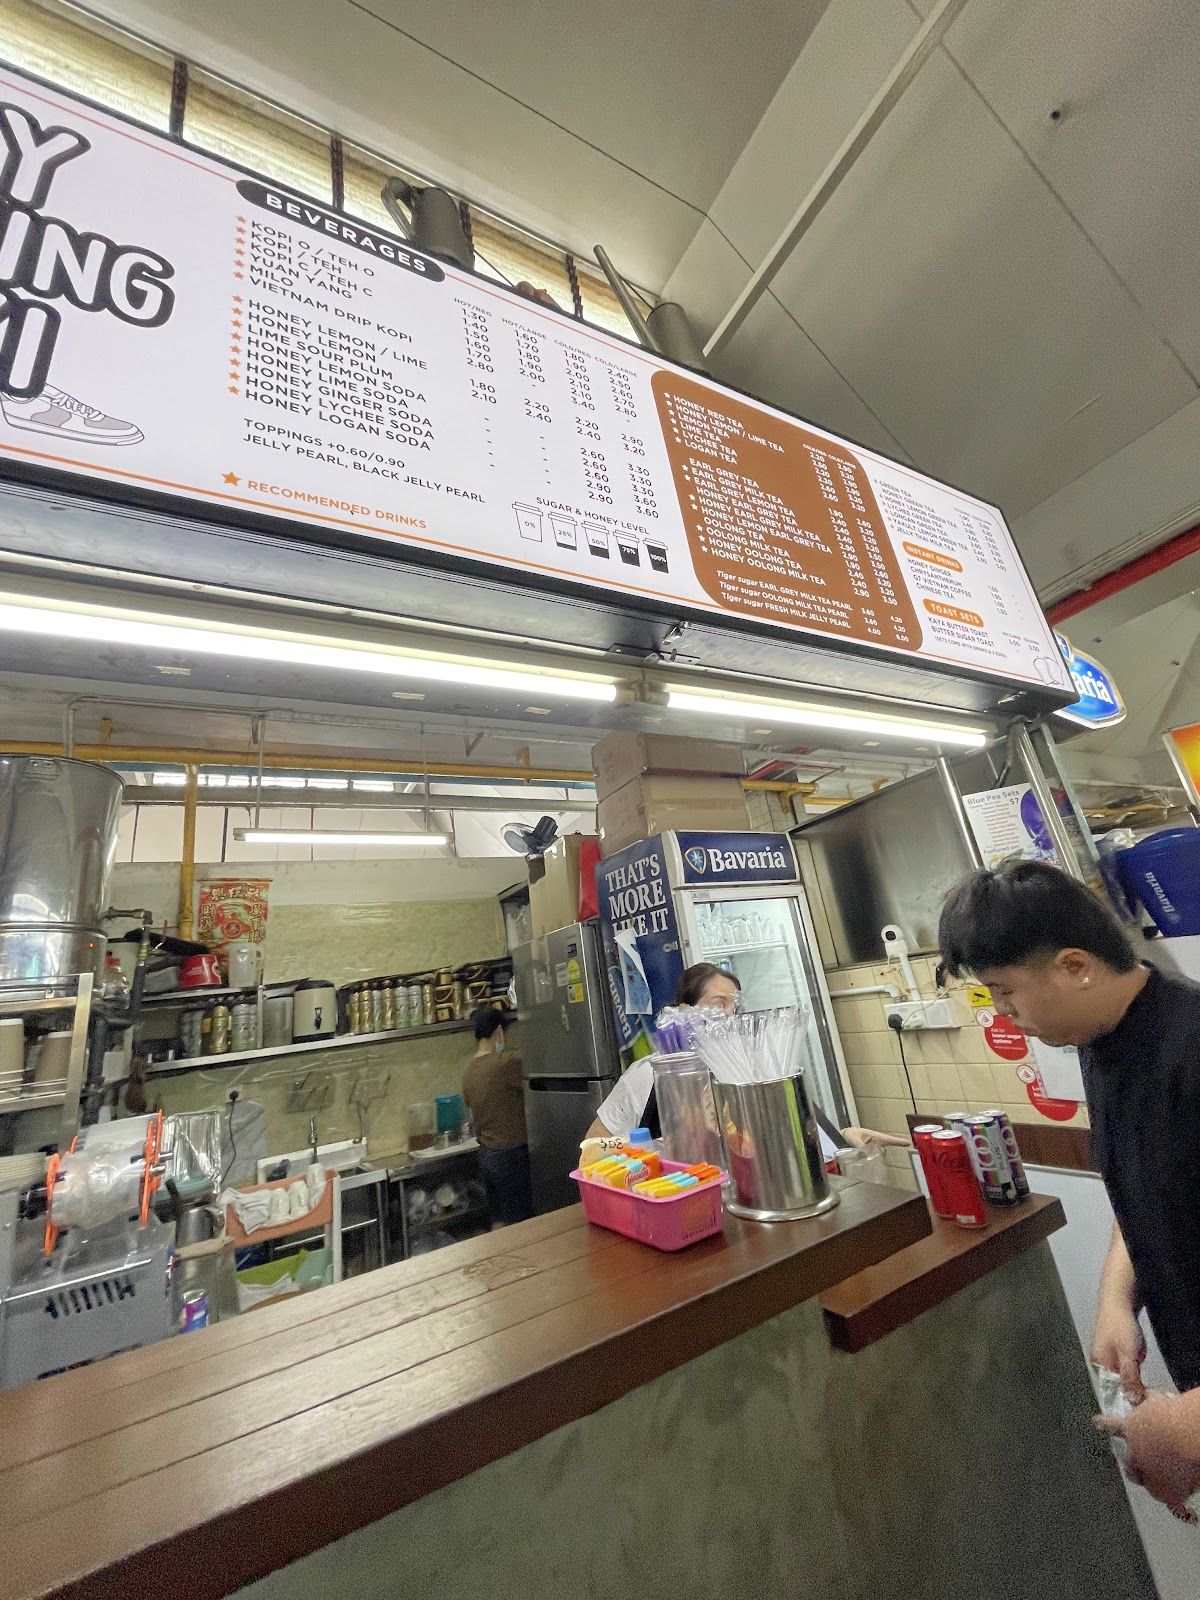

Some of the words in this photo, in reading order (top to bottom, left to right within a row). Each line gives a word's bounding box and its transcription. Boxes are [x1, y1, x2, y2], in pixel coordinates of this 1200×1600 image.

[266, 193, 425, 271] BEVERAGES
[251, 220, 291, 243] KOPI
[298, 240, 310, 249] O
[328, 251, 357, 270] TEH
[363, 267, 374, 276] O
[251, 230, 291, 253] KOPI
[310, 255, 341, 274] TEH
[250, 241, 291, 264] KOPI
[297, 261, 308, 271] C
[327, 272, 357, 290] TEH
[362, 287, 372, 296] C
[250, 252, 299, 278] YUAN
[305, 274, 351, 298] YANG
[250, 264, 293, 286] MILO
[249, 275, 328, 312] VIETNAM
[334, 307, 371, 326] DRIP
[376, 323, 411, 342] KOPI
[461, 307, 486, 322] 1.30
[248, 299, 311, 327] HONEY
[318, 324, 375, 351] LEMON
[392, 351, 427, 370] LIME
[462, 317, 487, 332] 1.40
[463, 327, 488, 342] 1.50
[248, 311, 311, 339] HONEY
[318, 335, 375, 363] LEMON
[464, 337, 490, 352] 1.60
[514, 329, 537, 344] 1.60
[515, 338, 538, 353] 1.70
[248, 323, 290, 345] LIME
[296, 340, 343, 363] SOUR
[349, 358, 392, 380] PLUM
[466, 347, 491, 362] 1.70
[517, 348, 540, 362] 1.80
[563, 349, 584, 363] 1.80
[247, 336, 311, 364] HONEY
[318, 359, 376, 386] LEMON
[382, 381, 426, 402] SODA
[518, 358, 542, 372] 1.90
[519, 367, 545, 382] 2.00
[564, 358, 586, 372] 1.90
[565, 367, 589, 382] 2.00
[607, 367, 628, 381] 2.40
[247, 348, 312, 376] HONEY
[318, 372, 357, 392] LIME
[363, 386, 408, 408] SODA
[568, 377, 590, 391] 2.10
[609, 376, 630, 390] 2.50
[246, 362, 311, 389] HONEY
[318, 385, 382, 412] GINGER
[388, 406, 432, 427] SODA
[570, 387, 592, 400] 2.10
[611, 385, 632, 399] 2.60
[613, 395, 634, 408] 2.70
[246, 375, 311, 402] HONEY
[318, 397, 384, 425] LYCHEE
[390, 419, 434, 440] SODA
[615, 404, 636, 417] 2.80
[673, 394, 704, 413] HONEY
[706, 408, 725, 421] RED
[726, 416, 744, 429] TEA
[245, 388, 312, 415] HONEY
[318, 410, 379, 436] LOGAN
[385, 430, 430, 450] SODA
[677, 412, 710, 430] LEMON
[711, 425, 729, 438] TEA
[243, 417, 322, 446] TOPPINGS
[327, 442, 404, 468] +0.60/0.90
[243, 433, 290, 451] JELLY
[296, 446, 347, 468] PEARL,
[353, 461, 399, 480] BLACK
[403, 475, 441, 490] JELLY
[446, 485, 485, 503] PEARL
[691, 466, 716, 481] EARL
[718, 476, 741, 490] GREY
[743, 485, 765, 499] MILK
[765, 493, 783, 505] TEA
[247, 479, 370, 515] RECOMMENDED
[375, 509, 426, 528] DRINKS
[524, 520, 535, 528] 0%
[536, 496, 572, 512] SUGAR
[584, 510, 617, 525] HONEY
[620, 521, 649, 534] LEVEL
[558, 529, 572, 537] 25%
[700, 505, 733, 522] HONEY
[736, 517, 768, 533] LEMON
[769, 527, 792, 541] EARL
[792, 535, 814, 547] GREY
[815, 542, 832, 553] TEA
[591, 538, 605, 546] 50%
[622, 546, 635, 554] 75%
[705, 526, 748, 545] OOLONG
[749, 539, 771, 552] MILK
[772, 546, 790, 558] TEA
[649, 553, 666, 562] 100%
[906, 545, 934, 559] INSTANT
[935, 555, 959, 568] DRINKS
[847, 568, 864, 579] 2.40
[876, 577, 891, 587] 3.20
[915, 582, 942, 595] CHINESE
[942, 590, 955, 599] TEA
[921, 576, 949, 590] VIETNAM
[949, 585, 972, 597] COFFEE
[718, 580, 739, 591] Tiger
[740, 587, 760, 596] sugar
[761, 591, 794, 605] OOLONG
[794, 599, 812, 609] MILK
[812, 604, 827, 613] TEA
[826, 607, 849, 618] PEARL
[930, 603, 957, 617] TOAST
[959, 611, 979, 624] SETS
[927, 616, 946, 626] KAYA
[946, 621, 969, 633] BUTTER
[969, 627, 987, 637] TOAST
[1076, 670, 1114, 704] aria
[967, 796, 985, 805] Blue
[987, 794, 1001, 802] Pea
[1002, 790, 1020, 798] Sets
[707, 847, 786, 872] Bavaria
[983, 846, 1010, 854] Featured
[605, 854, 660, 892] THAT'S
[609, 878, 667, 920] MORE
[1145, 872, 1175, 913] Bavaria
[650, 907, 668, 933] IT
